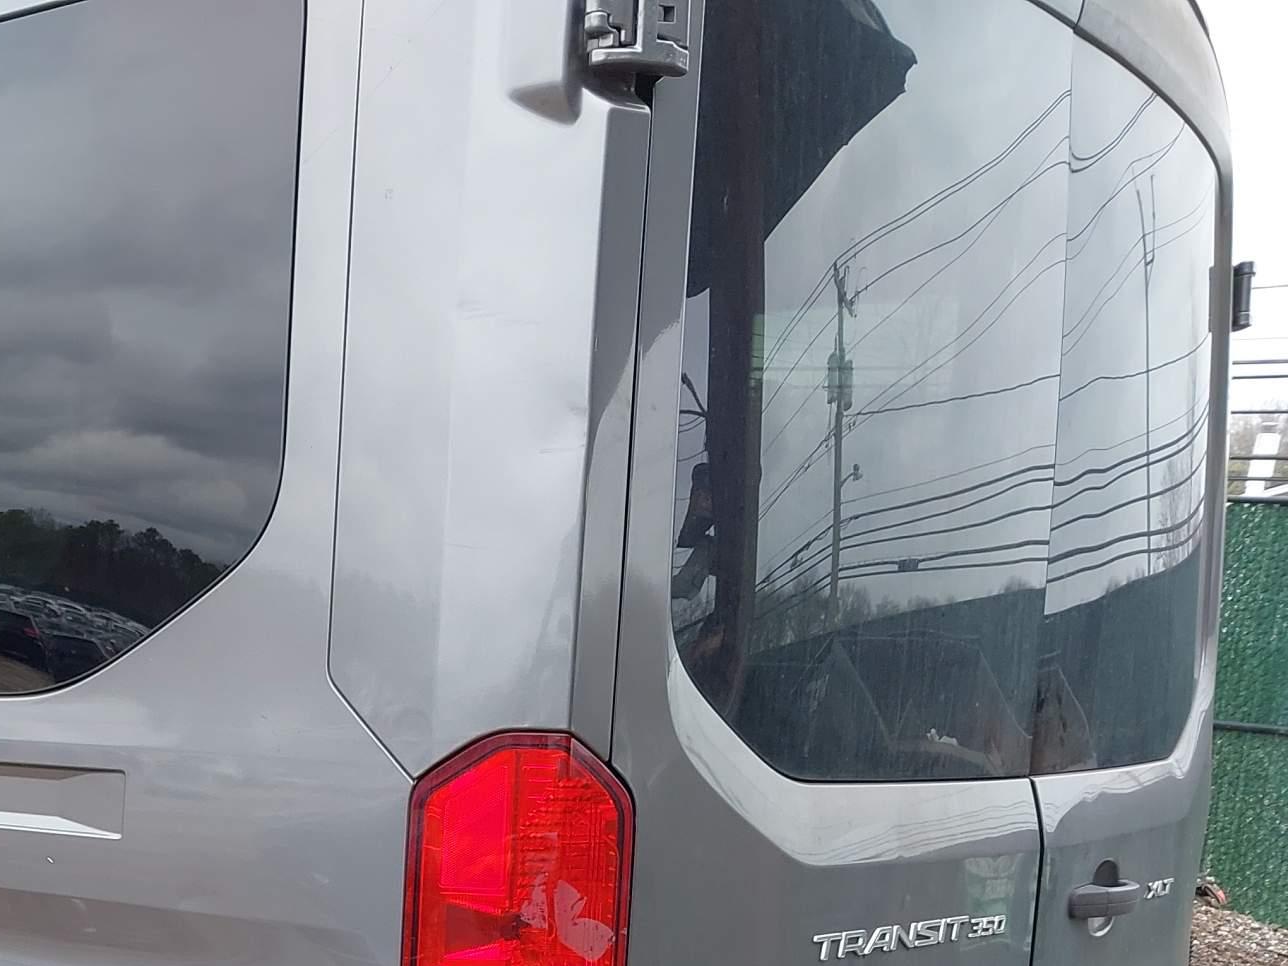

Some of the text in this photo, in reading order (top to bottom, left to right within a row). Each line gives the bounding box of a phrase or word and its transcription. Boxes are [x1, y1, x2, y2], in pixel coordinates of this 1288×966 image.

[1143, 877, 1175, 899] XLT
[813, 914, 1006, 961] TRANSIT 350
